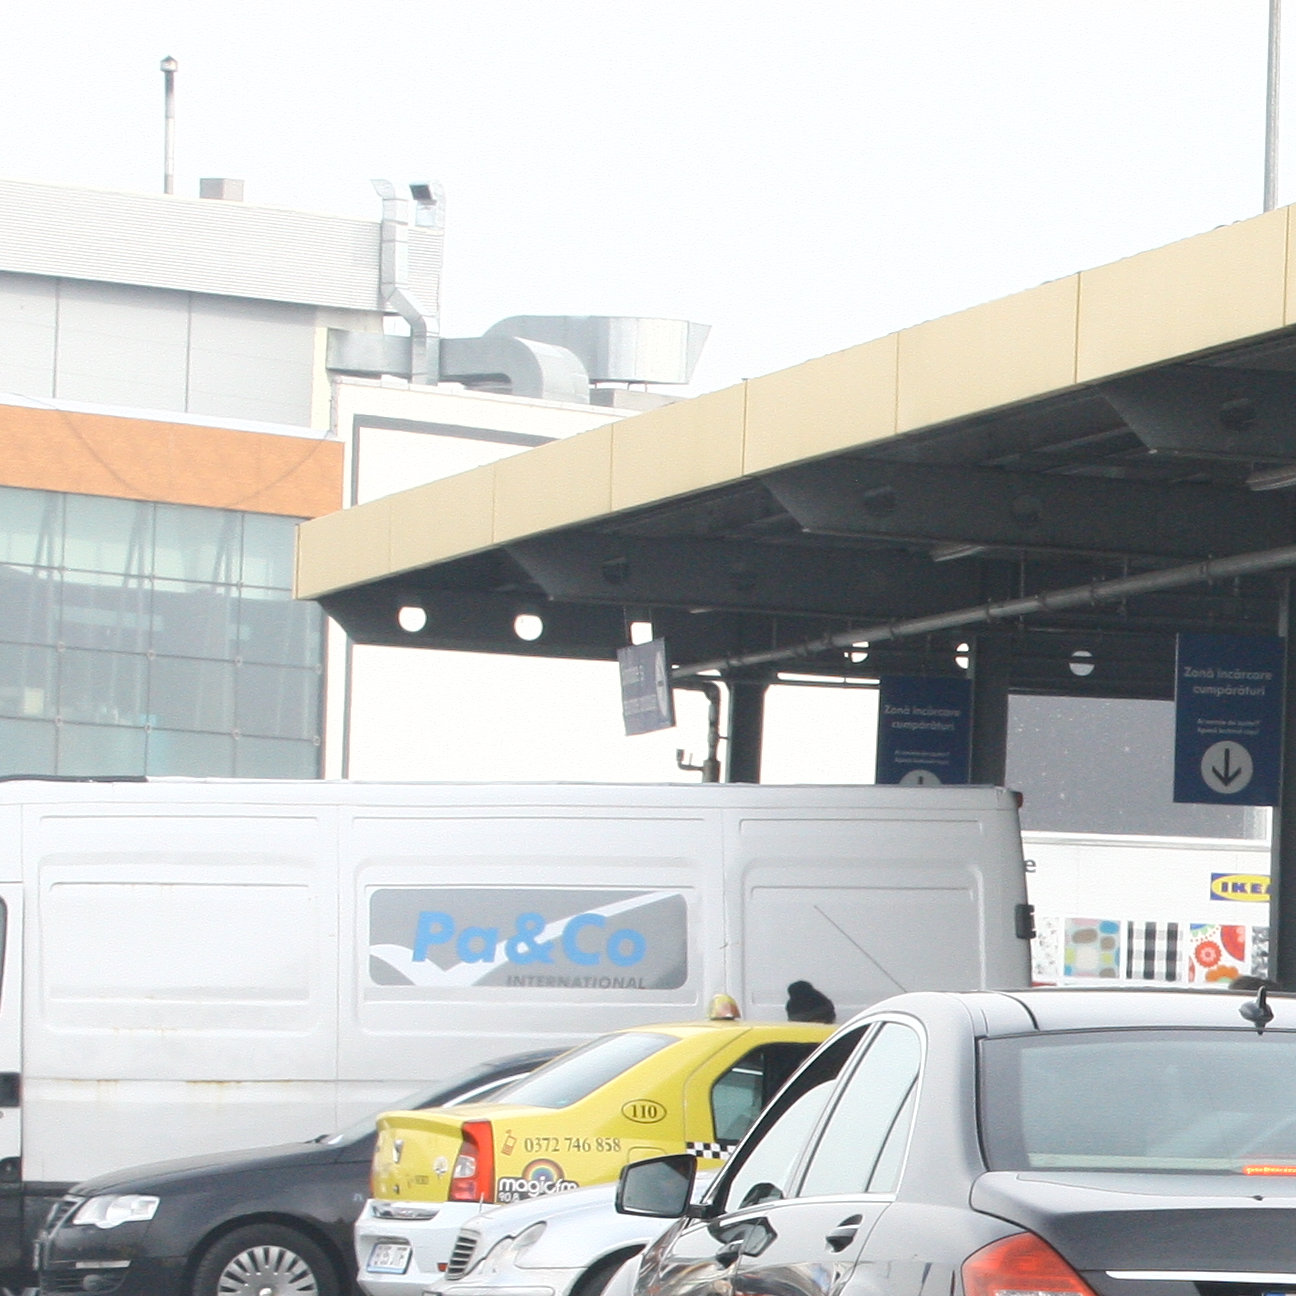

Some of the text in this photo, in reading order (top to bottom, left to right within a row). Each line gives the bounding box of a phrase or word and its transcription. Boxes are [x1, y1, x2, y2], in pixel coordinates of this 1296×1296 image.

[412, 911, 647, 967] Pa&Co
[507, 975, 647, 989] INTERNATIONAL
[632, 1105, 657, 1118] 110
[524, 1138, 621, 1152] 0372 746 858
